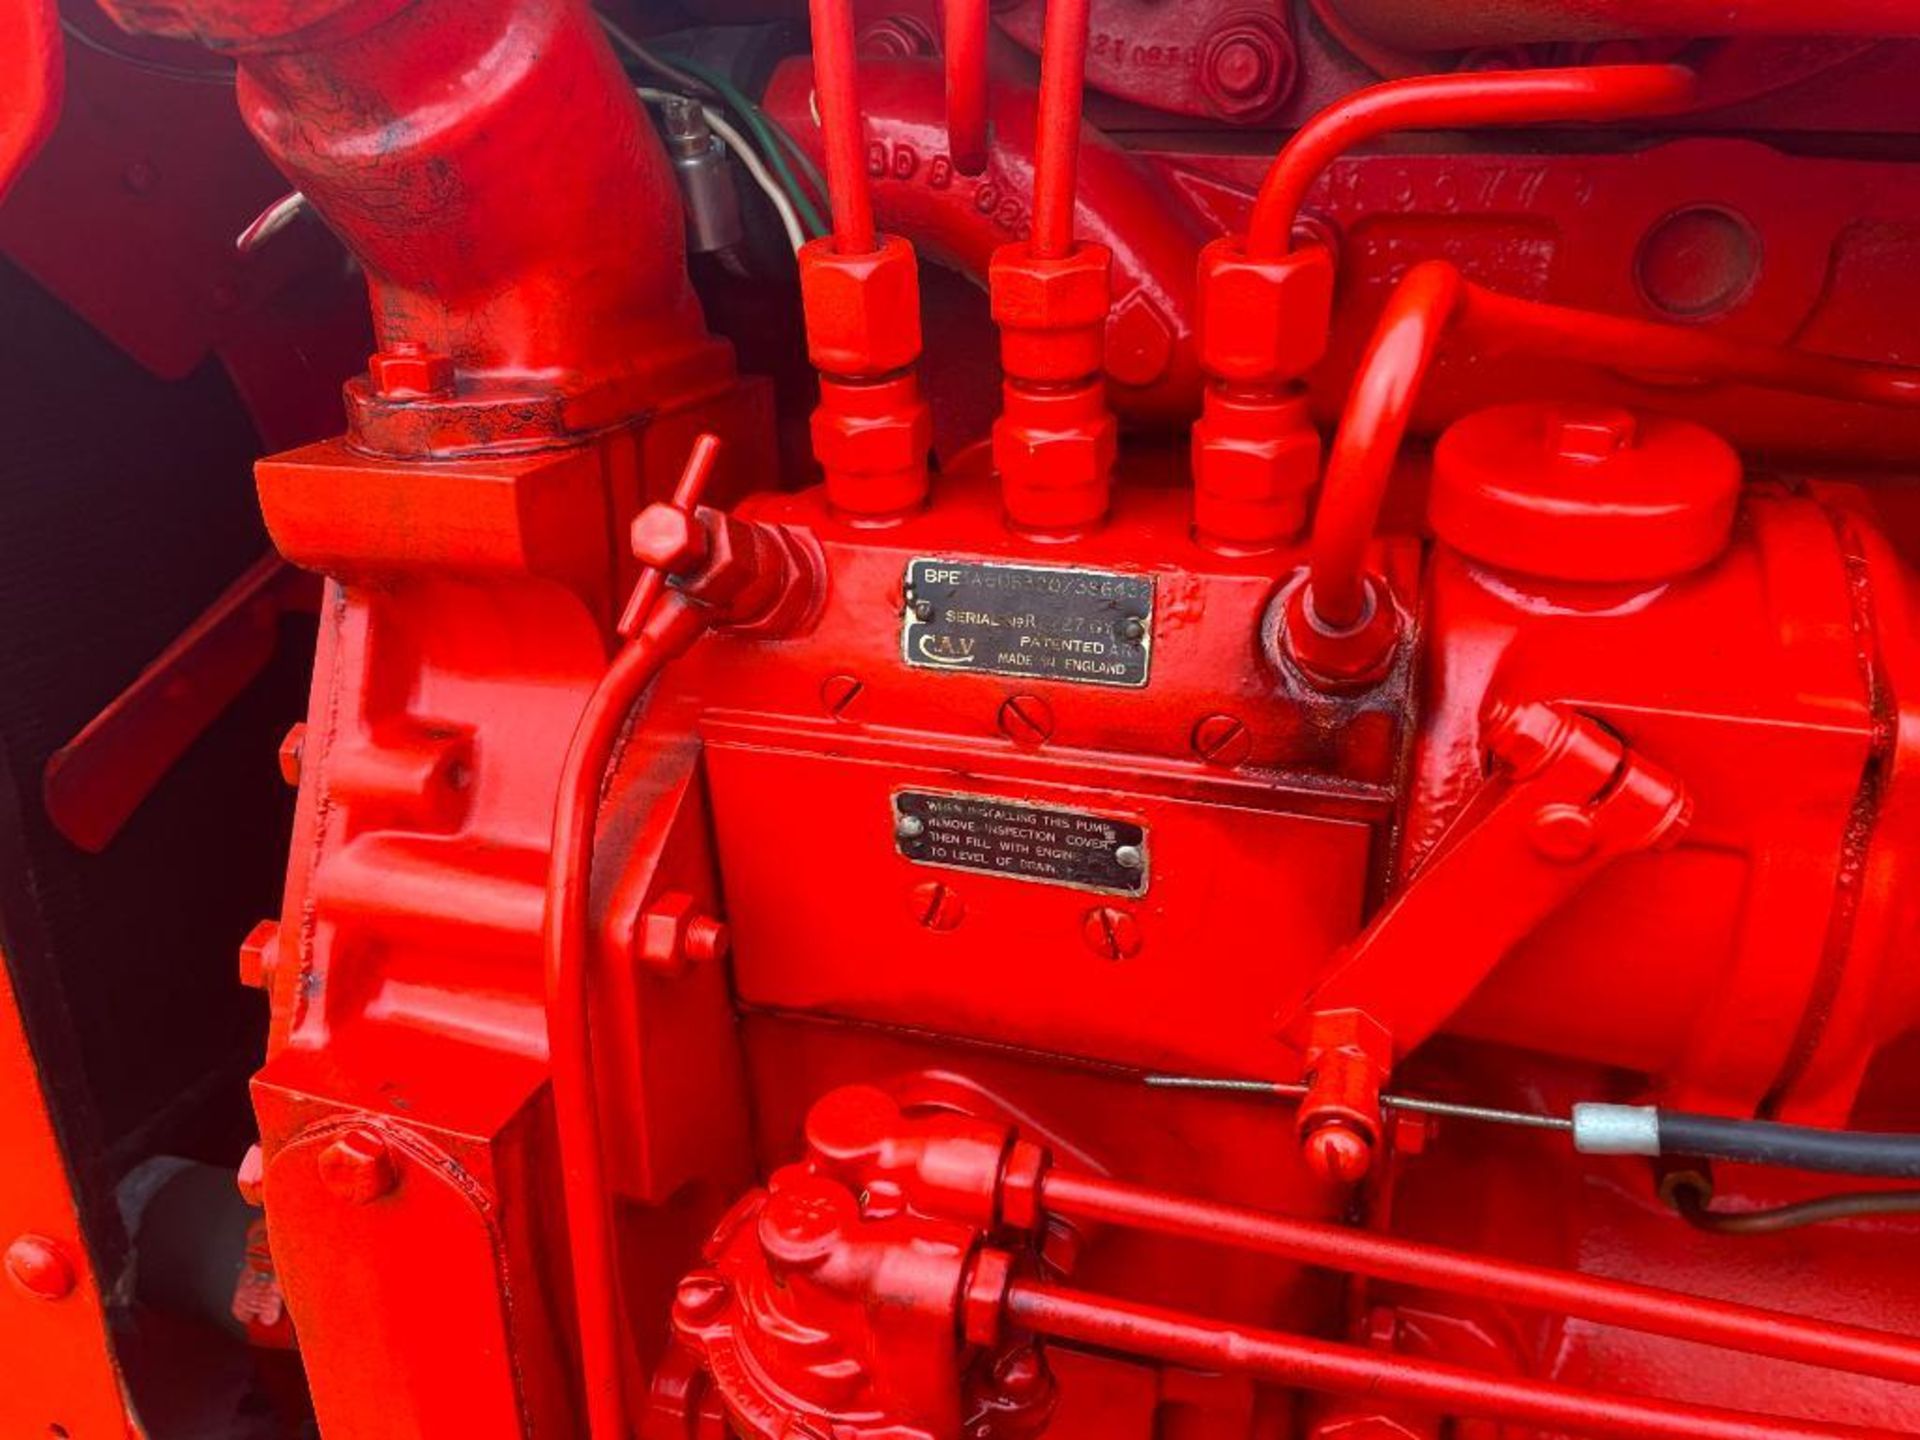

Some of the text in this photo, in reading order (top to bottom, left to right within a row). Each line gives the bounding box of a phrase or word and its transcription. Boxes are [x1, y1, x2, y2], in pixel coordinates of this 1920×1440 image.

[924, 568, 962, 585] BPE
[945, 609, 1001, 626] SERIAL
[1019, 636, 1105, 655] PATENTED
[997, 652, 1033, 666] MADE
[1065, 658, 1127, 676] ENGLAND
[928, 818, 975, 832] REMOVE
[984, 823, 1057, 843] INSPECTION
[1043, 815, 1071, 829] THIS
[1076, 819, 1111, 833] PUMP
[929, 830, 961, 845] THEN
[966, 836, 992, 850] FILL
[1000, 841, 1030, 854] WITH
[931, 846, 947, 858] TO
[953, 849, 990, 865] LEVEL
[996, 856, 1014, 866] OF
